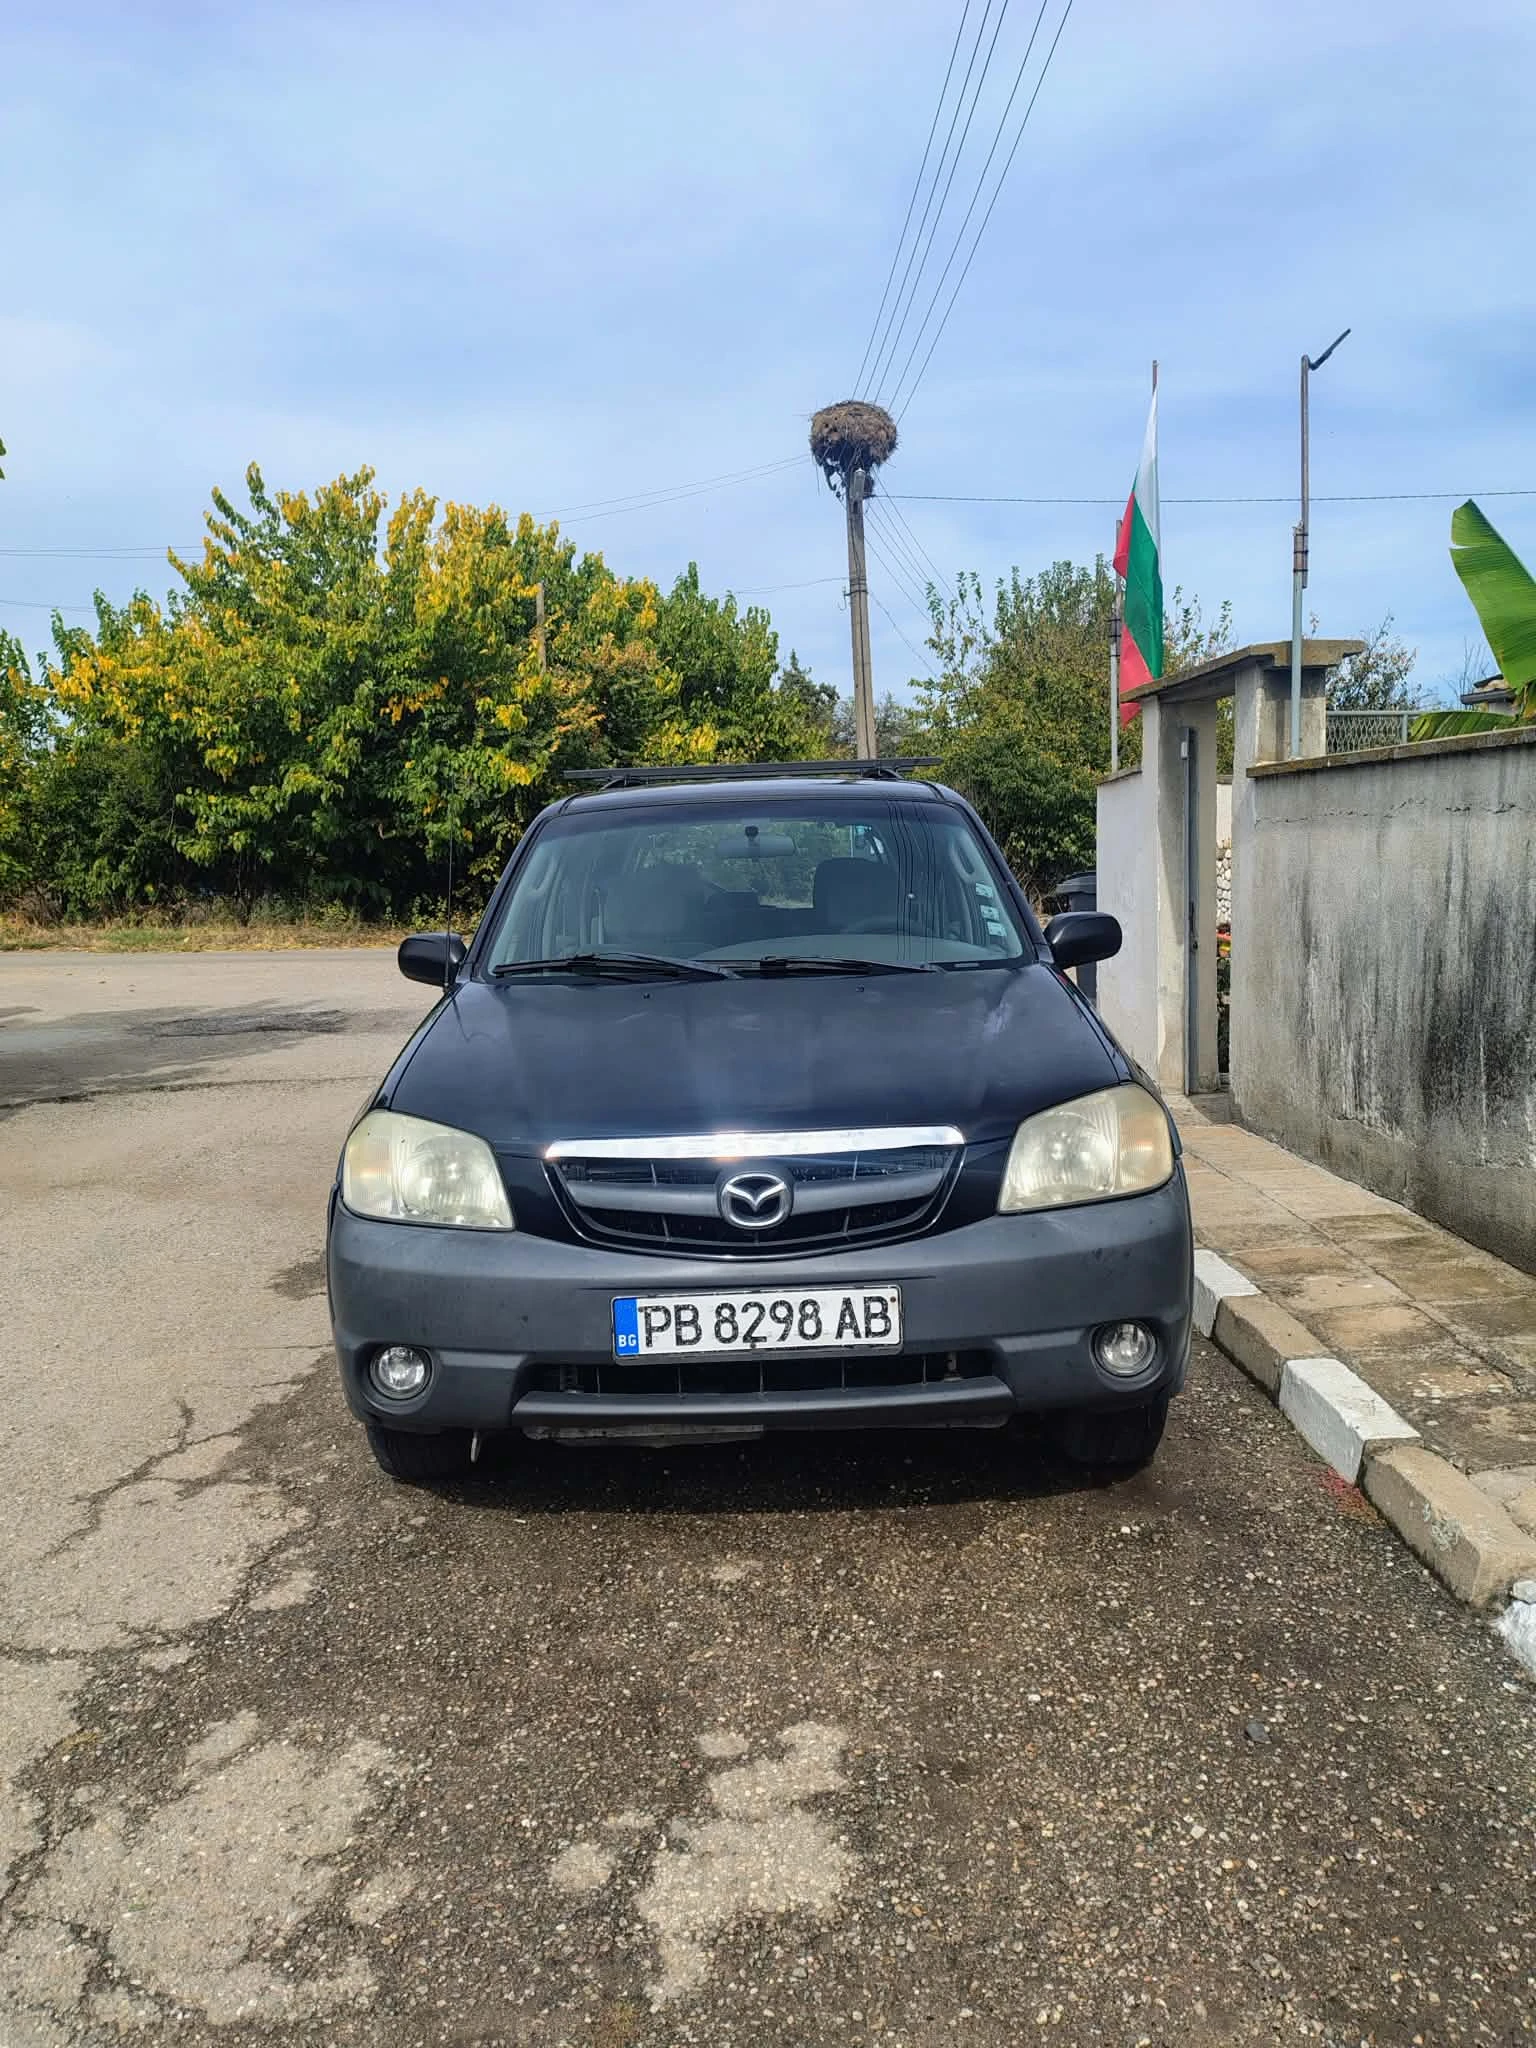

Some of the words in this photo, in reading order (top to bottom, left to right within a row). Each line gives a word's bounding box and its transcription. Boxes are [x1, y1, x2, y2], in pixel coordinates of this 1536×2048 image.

[639, 1302, 703, 1347] PB
[714, 1299, 822, 1344] 8298
[835, 1296, 892, 1340] AB
[618, 1333, 637, 1347] BG
